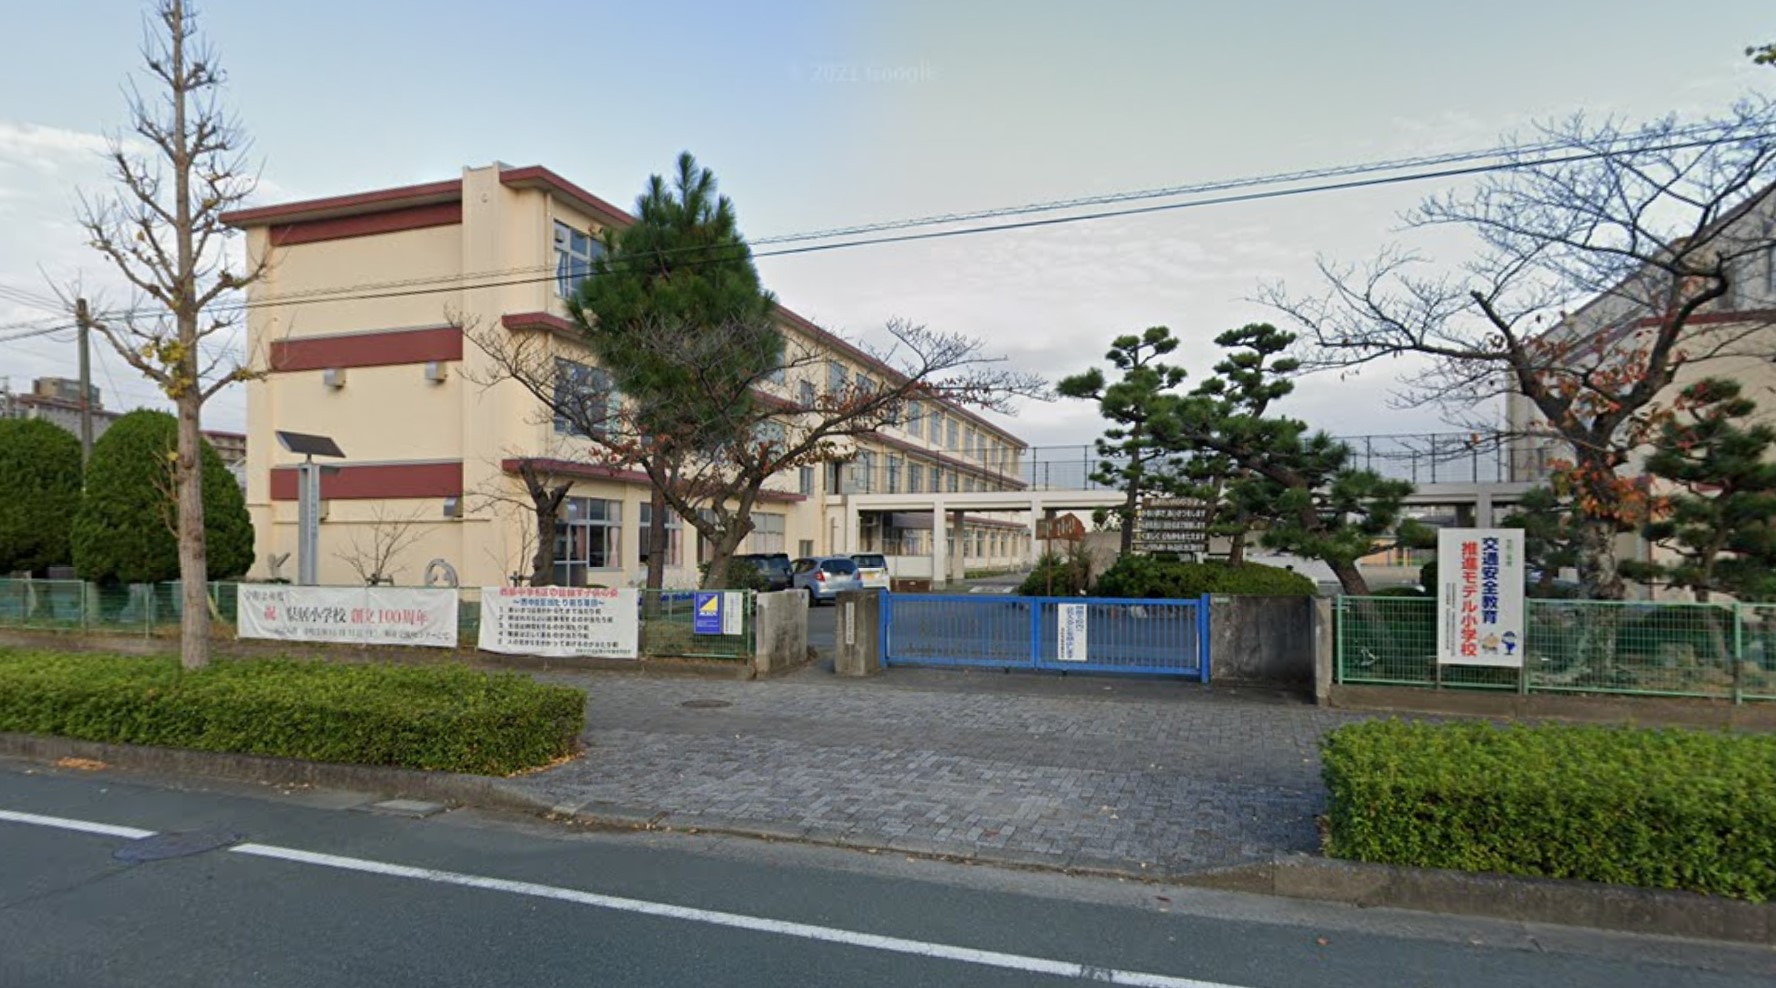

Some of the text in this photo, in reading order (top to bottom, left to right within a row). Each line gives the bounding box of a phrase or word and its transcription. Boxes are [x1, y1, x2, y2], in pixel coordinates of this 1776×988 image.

[1461, 541, 1478, 657] 推進モデル小学校
[1482, 537, 1499, 624] 交通安全教育
